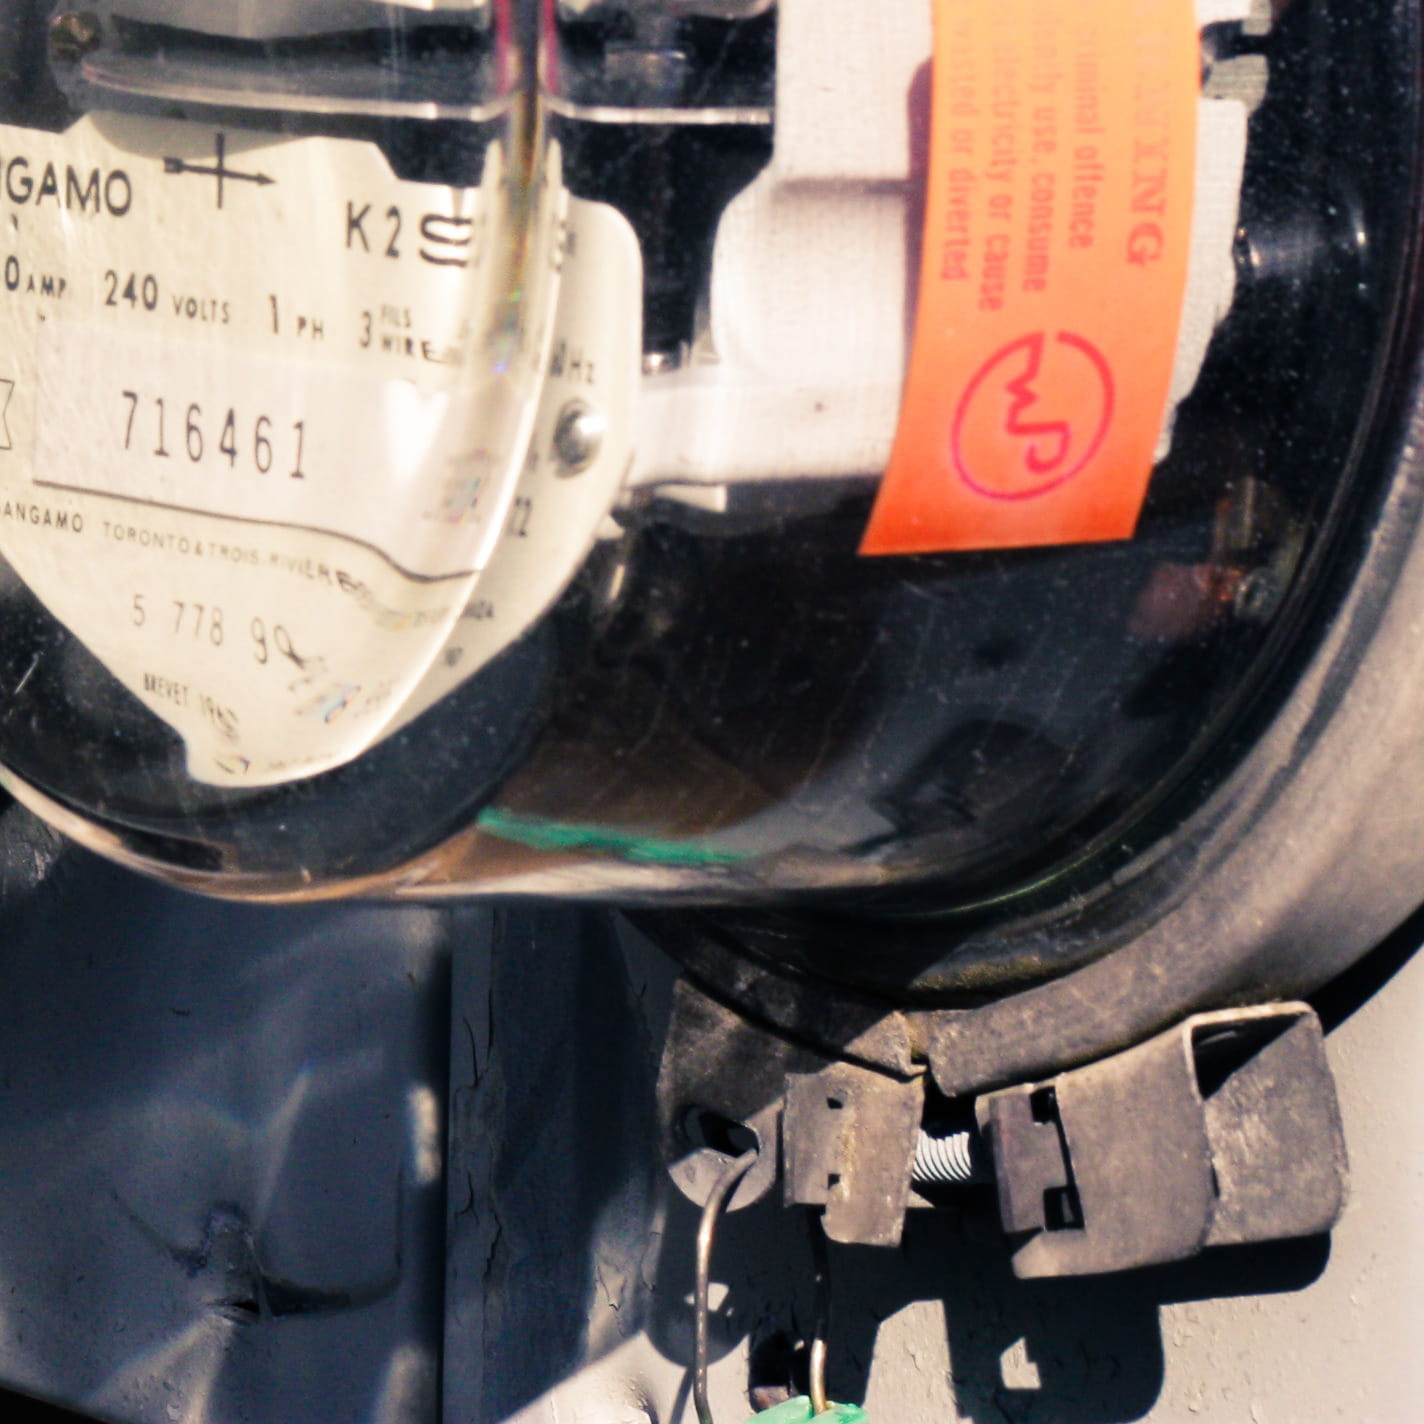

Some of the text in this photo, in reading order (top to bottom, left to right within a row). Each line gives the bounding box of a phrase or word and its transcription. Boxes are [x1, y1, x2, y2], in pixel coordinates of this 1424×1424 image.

[948, 129, 976, 158] or
[939, 168, 980, 283] diverted
[987, 193, 1015, 224] or
[1021, 173, 1058, 294] consume
[1068, 145, 1105, 250] offence
[26, 275, 67, 299] AMP
[104, 269, 158, 312] 240
[172, 294, 230, 324] VOLTS
[269, 293, 279, 334] 1
[297, 315, 325, 341] PH
[360, 311, 373, 349] 3
[978, 234, 1013, 313] cause
[122, 389, 307, 480] 716461
[103, 520, 190, 555] TORONTO
[208, 542, 260, 565] TROIS
[132, 593, 224, 647] 5 778
